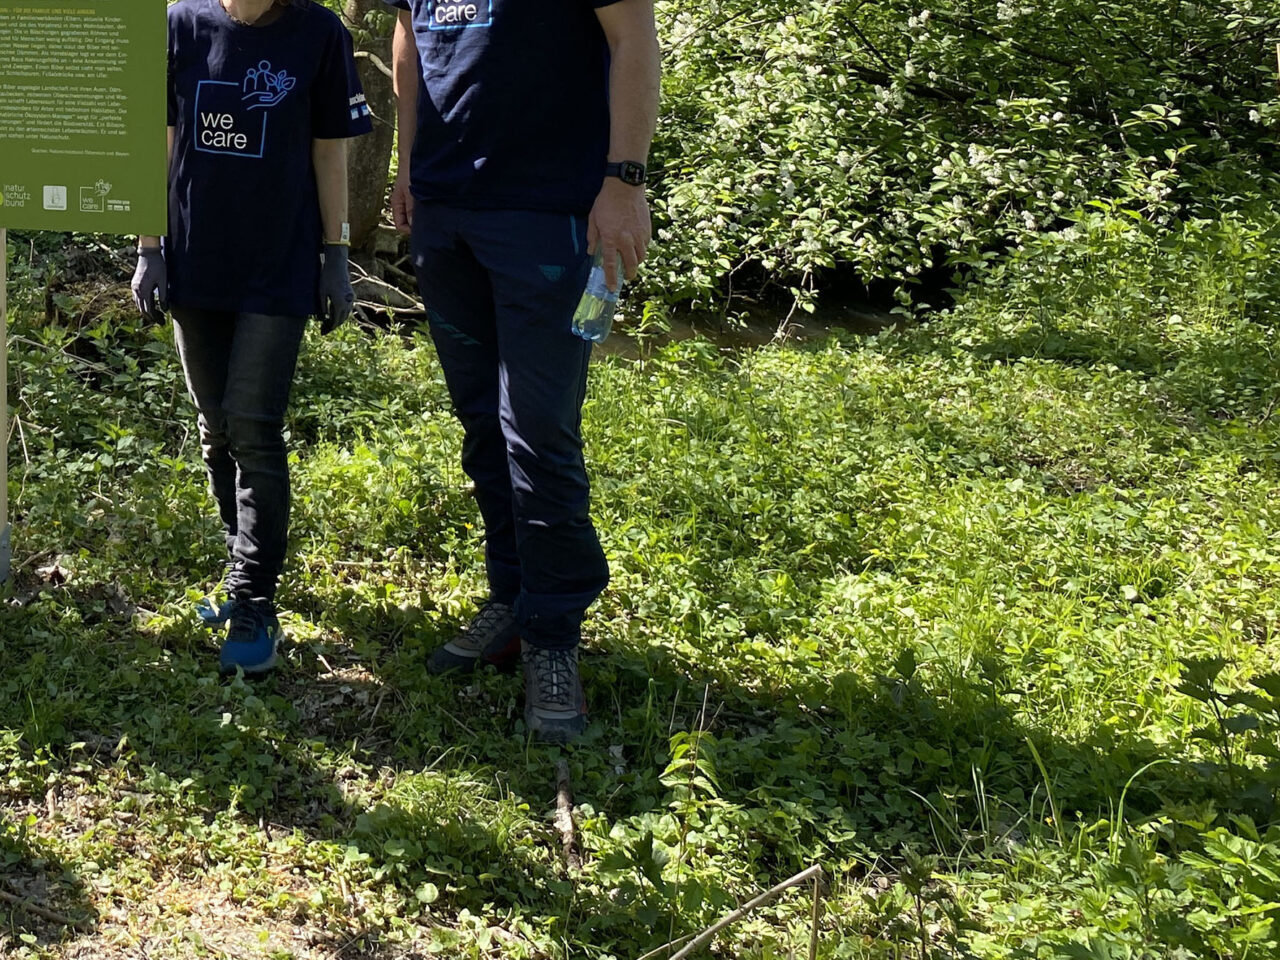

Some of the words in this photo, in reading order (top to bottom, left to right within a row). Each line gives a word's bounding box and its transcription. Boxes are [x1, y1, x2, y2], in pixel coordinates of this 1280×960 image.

[435, 3, 477, 23] care
[200, 111, 234, 130] we
[200, 129, 247, 150] care
